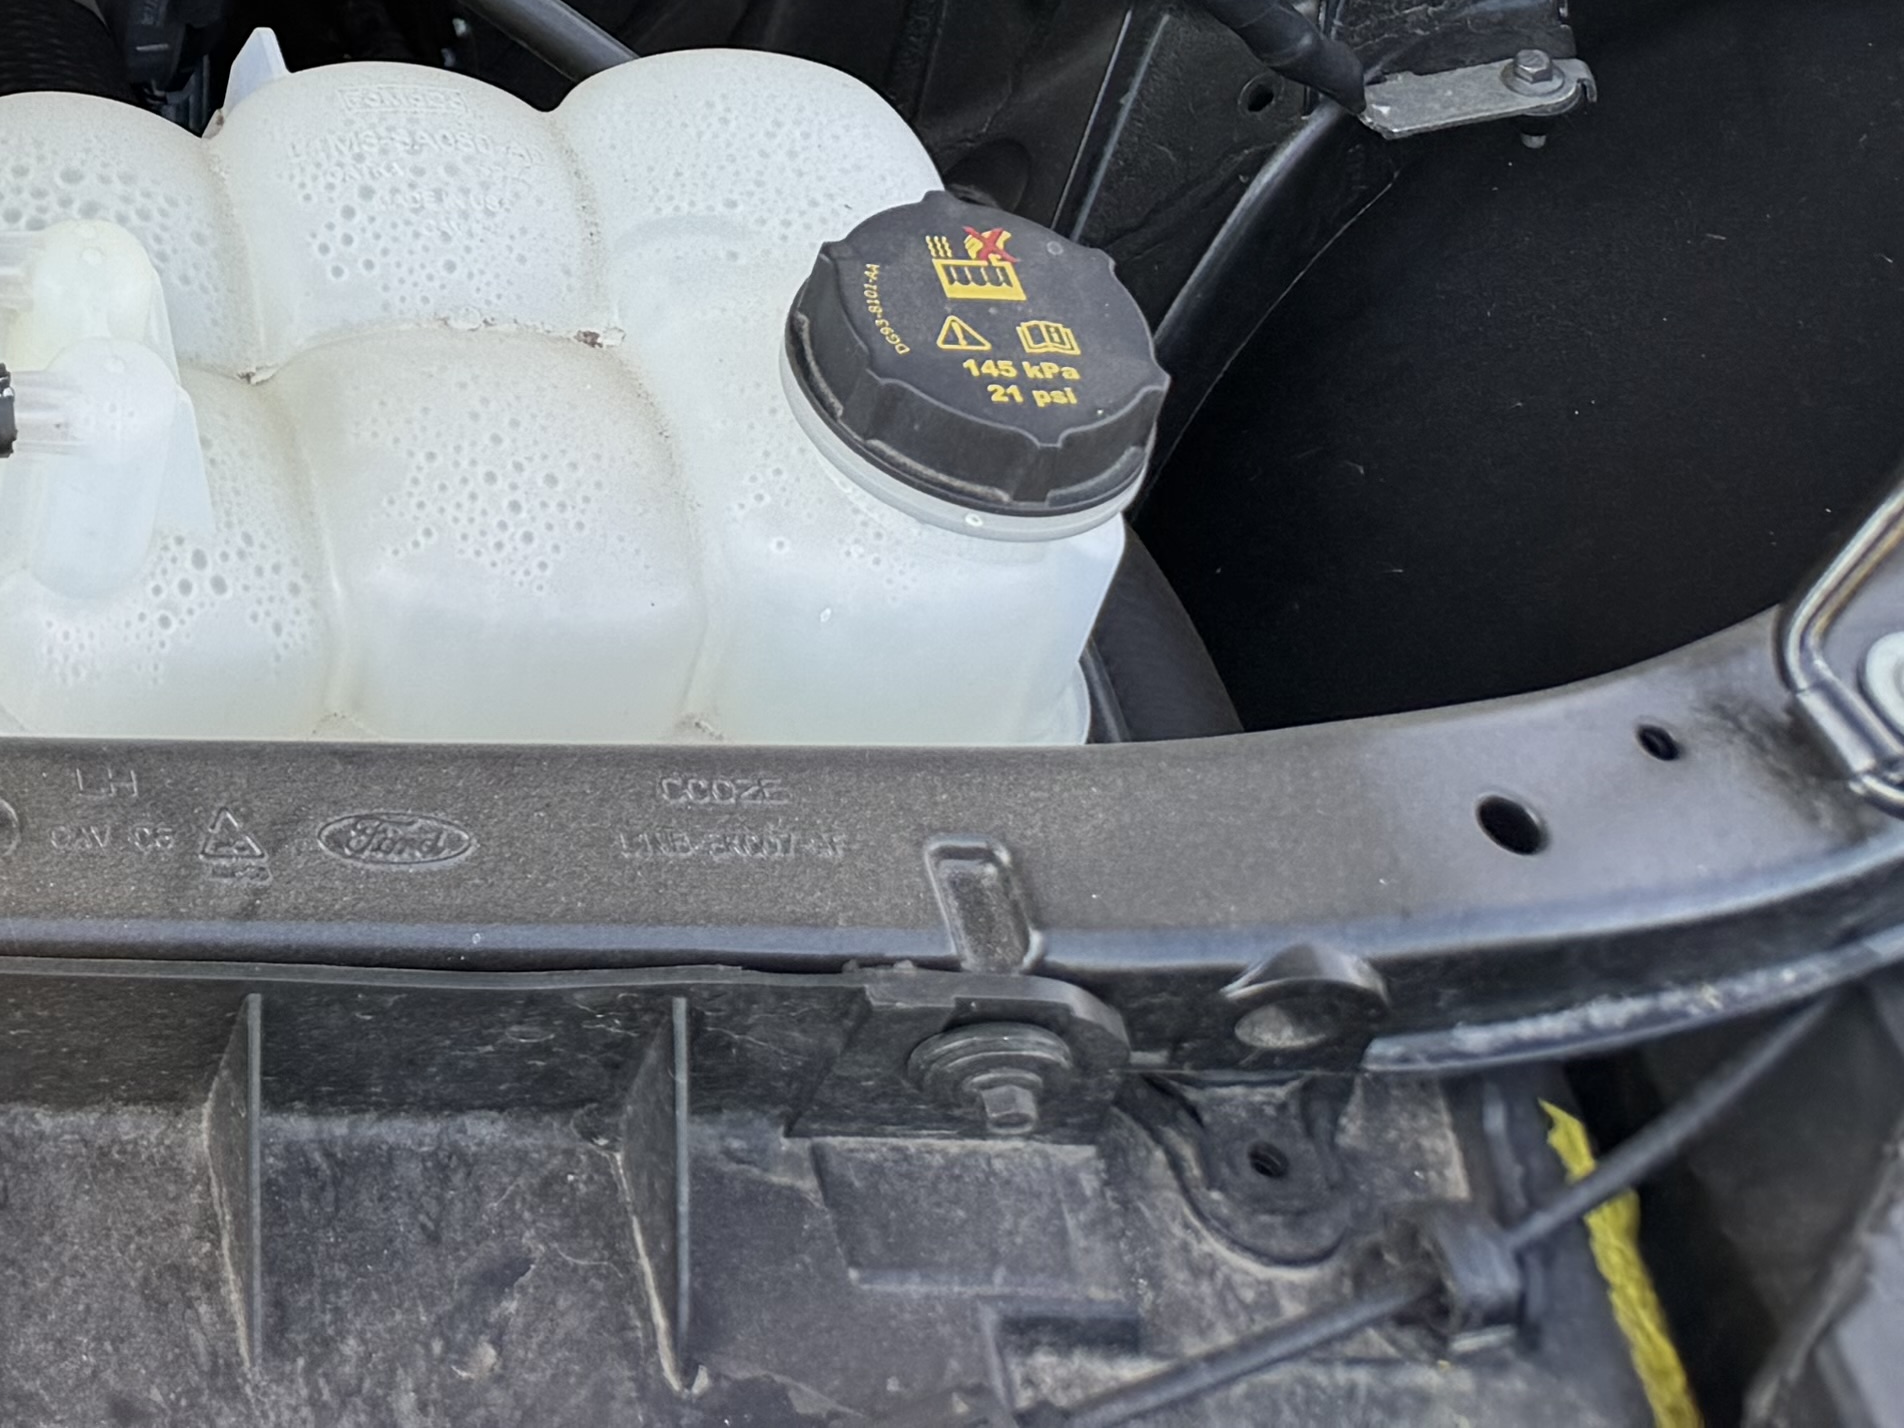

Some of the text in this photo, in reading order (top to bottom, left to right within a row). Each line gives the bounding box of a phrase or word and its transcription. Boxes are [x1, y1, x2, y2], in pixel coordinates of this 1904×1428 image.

[963, 358, 1081, 381] 145 kPa
[990, 383, 1078, 407] 21 psi
[75, 767, 140, 798] LH
